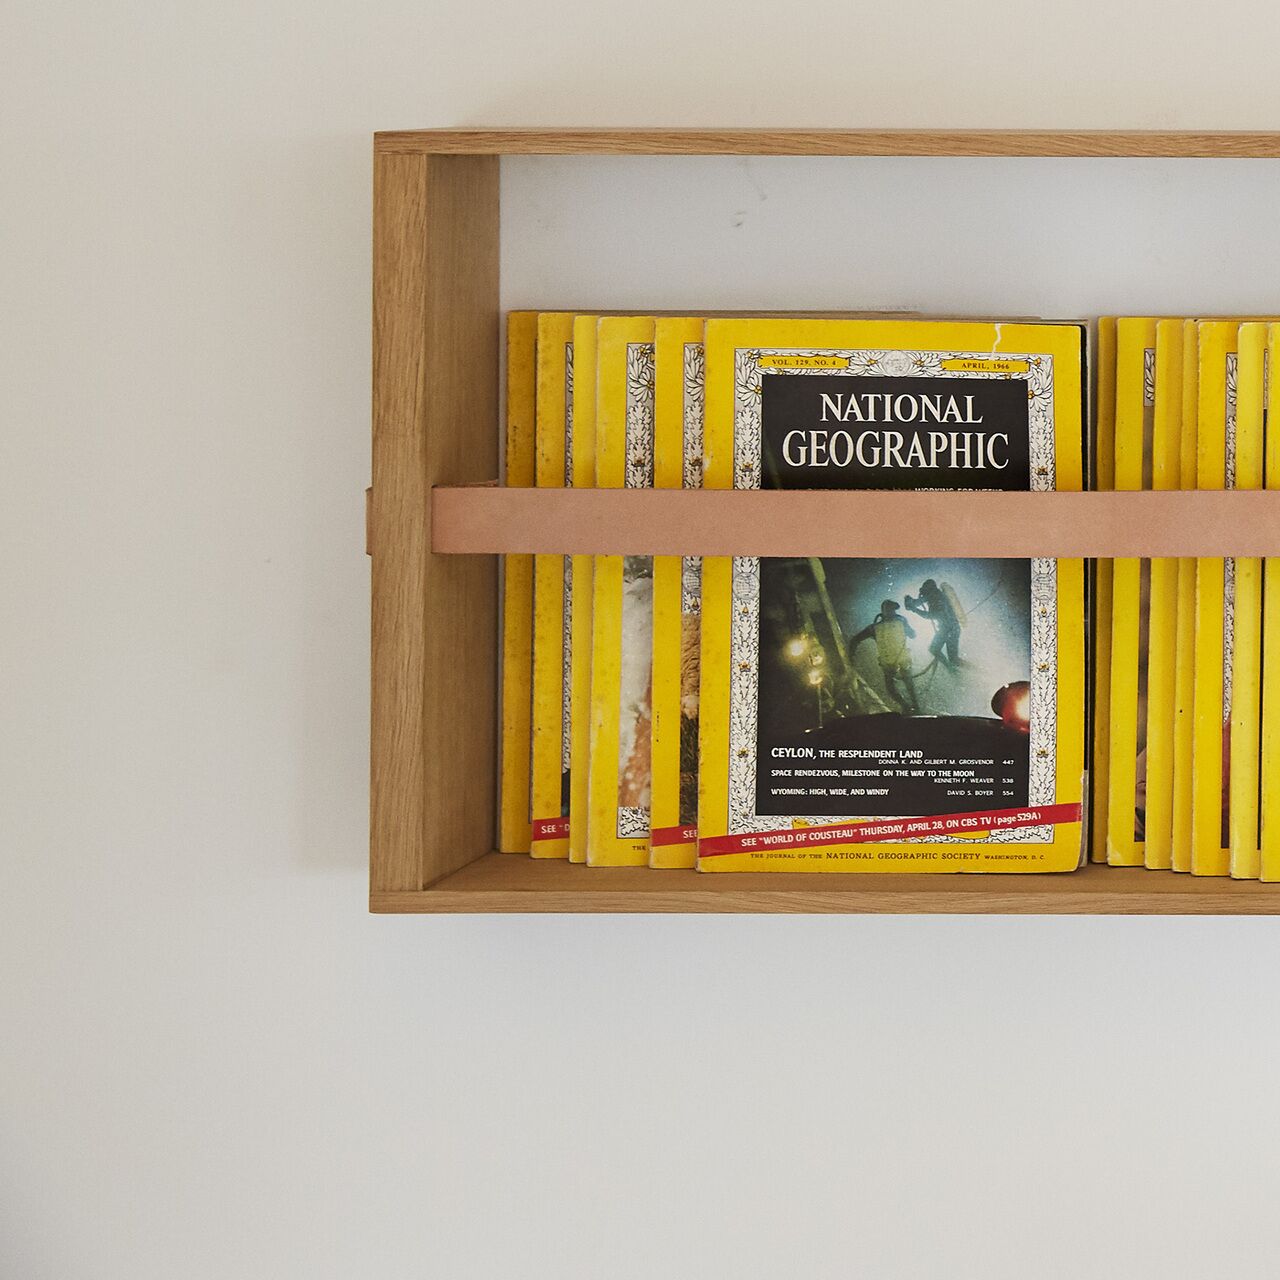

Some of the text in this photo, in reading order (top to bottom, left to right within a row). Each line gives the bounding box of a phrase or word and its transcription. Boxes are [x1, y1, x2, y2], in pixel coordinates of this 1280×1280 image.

[819, 393, 983, 424] NATIONAL
[782, 430, 1009, 469] GEOGRAPHIC
[771, 748, 923, 759] CEYLON, THE RESPLENDENT LAND
[794, 770, 840, 778] RENDEZVOUS,
[541, 825, 557, 834] SEE
[741, 838, 757, 847] SEE
[759, 834, 794, 845] "WORLD
[796, 833, 806, 842] OF
[809, 829, 857, 840] COUSTEAU"
[859, 825, 905, 836] THURSDAY,
[907, 823, 931, 832] APRIL
[932, 822, 945, 830] 28,
[946, 820, 959, 828] ON
[961, 819, 978, 827] CBS
[980, 817, 991, 825] TV
